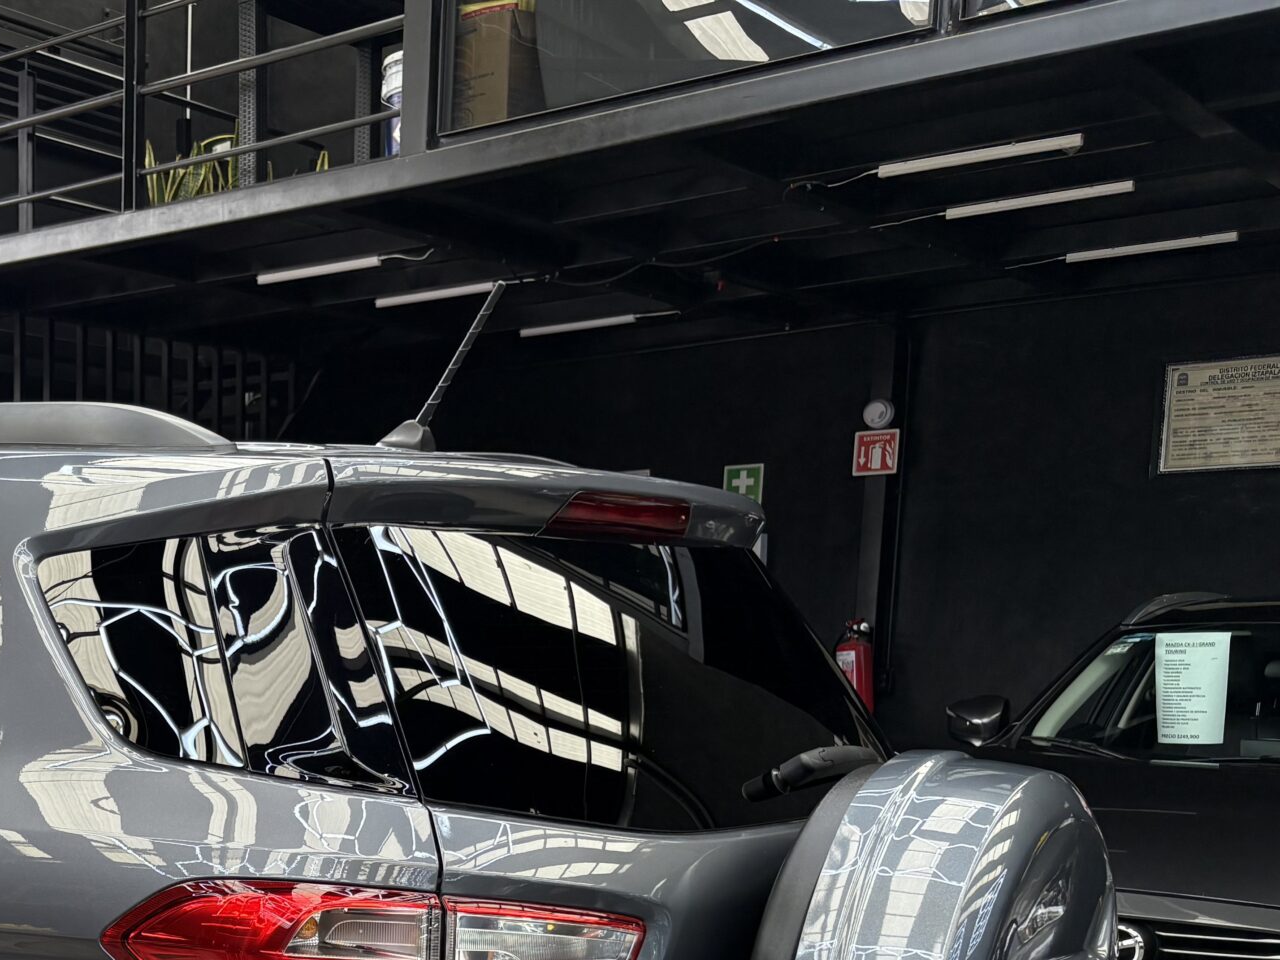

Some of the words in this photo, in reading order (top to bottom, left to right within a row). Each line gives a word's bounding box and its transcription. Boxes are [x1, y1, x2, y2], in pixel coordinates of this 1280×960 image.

[1219, 365, 1249, 374] DISTRITO
[1250, 363, 1280, 372] FEDERAL
[864, 434, 891, 442] EXTINTOR
